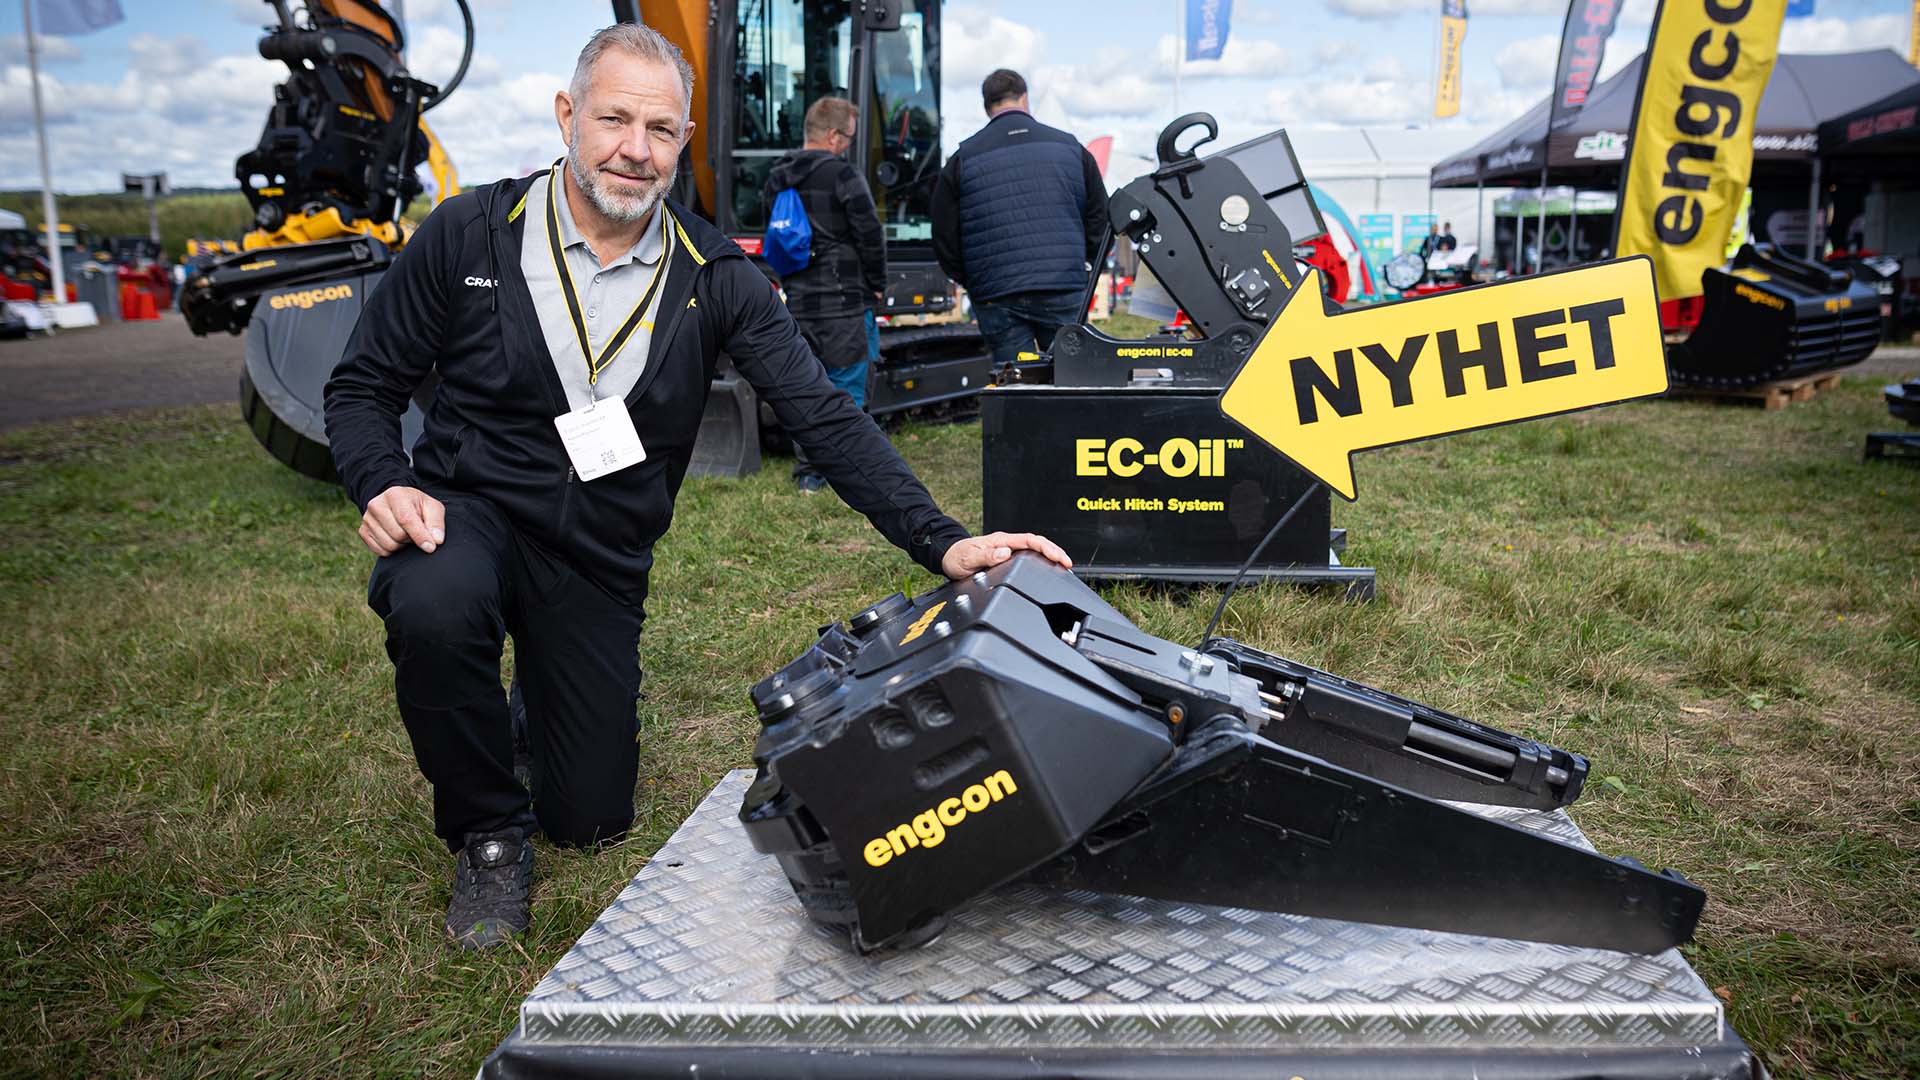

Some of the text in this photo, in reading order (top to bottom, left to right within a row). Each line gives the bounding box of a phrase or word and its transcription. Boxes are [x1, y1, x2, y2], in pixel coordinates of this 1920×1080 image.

[464, 276, 499, 288] CRA
[270, 284, 352, 310] engcon
[1117, 347, 1161, 358] engcon
[1289, 297, 1626, 425] NYHET
[1077, 497, 1224, 513] Quick Hitch System
[863, 768, 1018, 867] engcon
